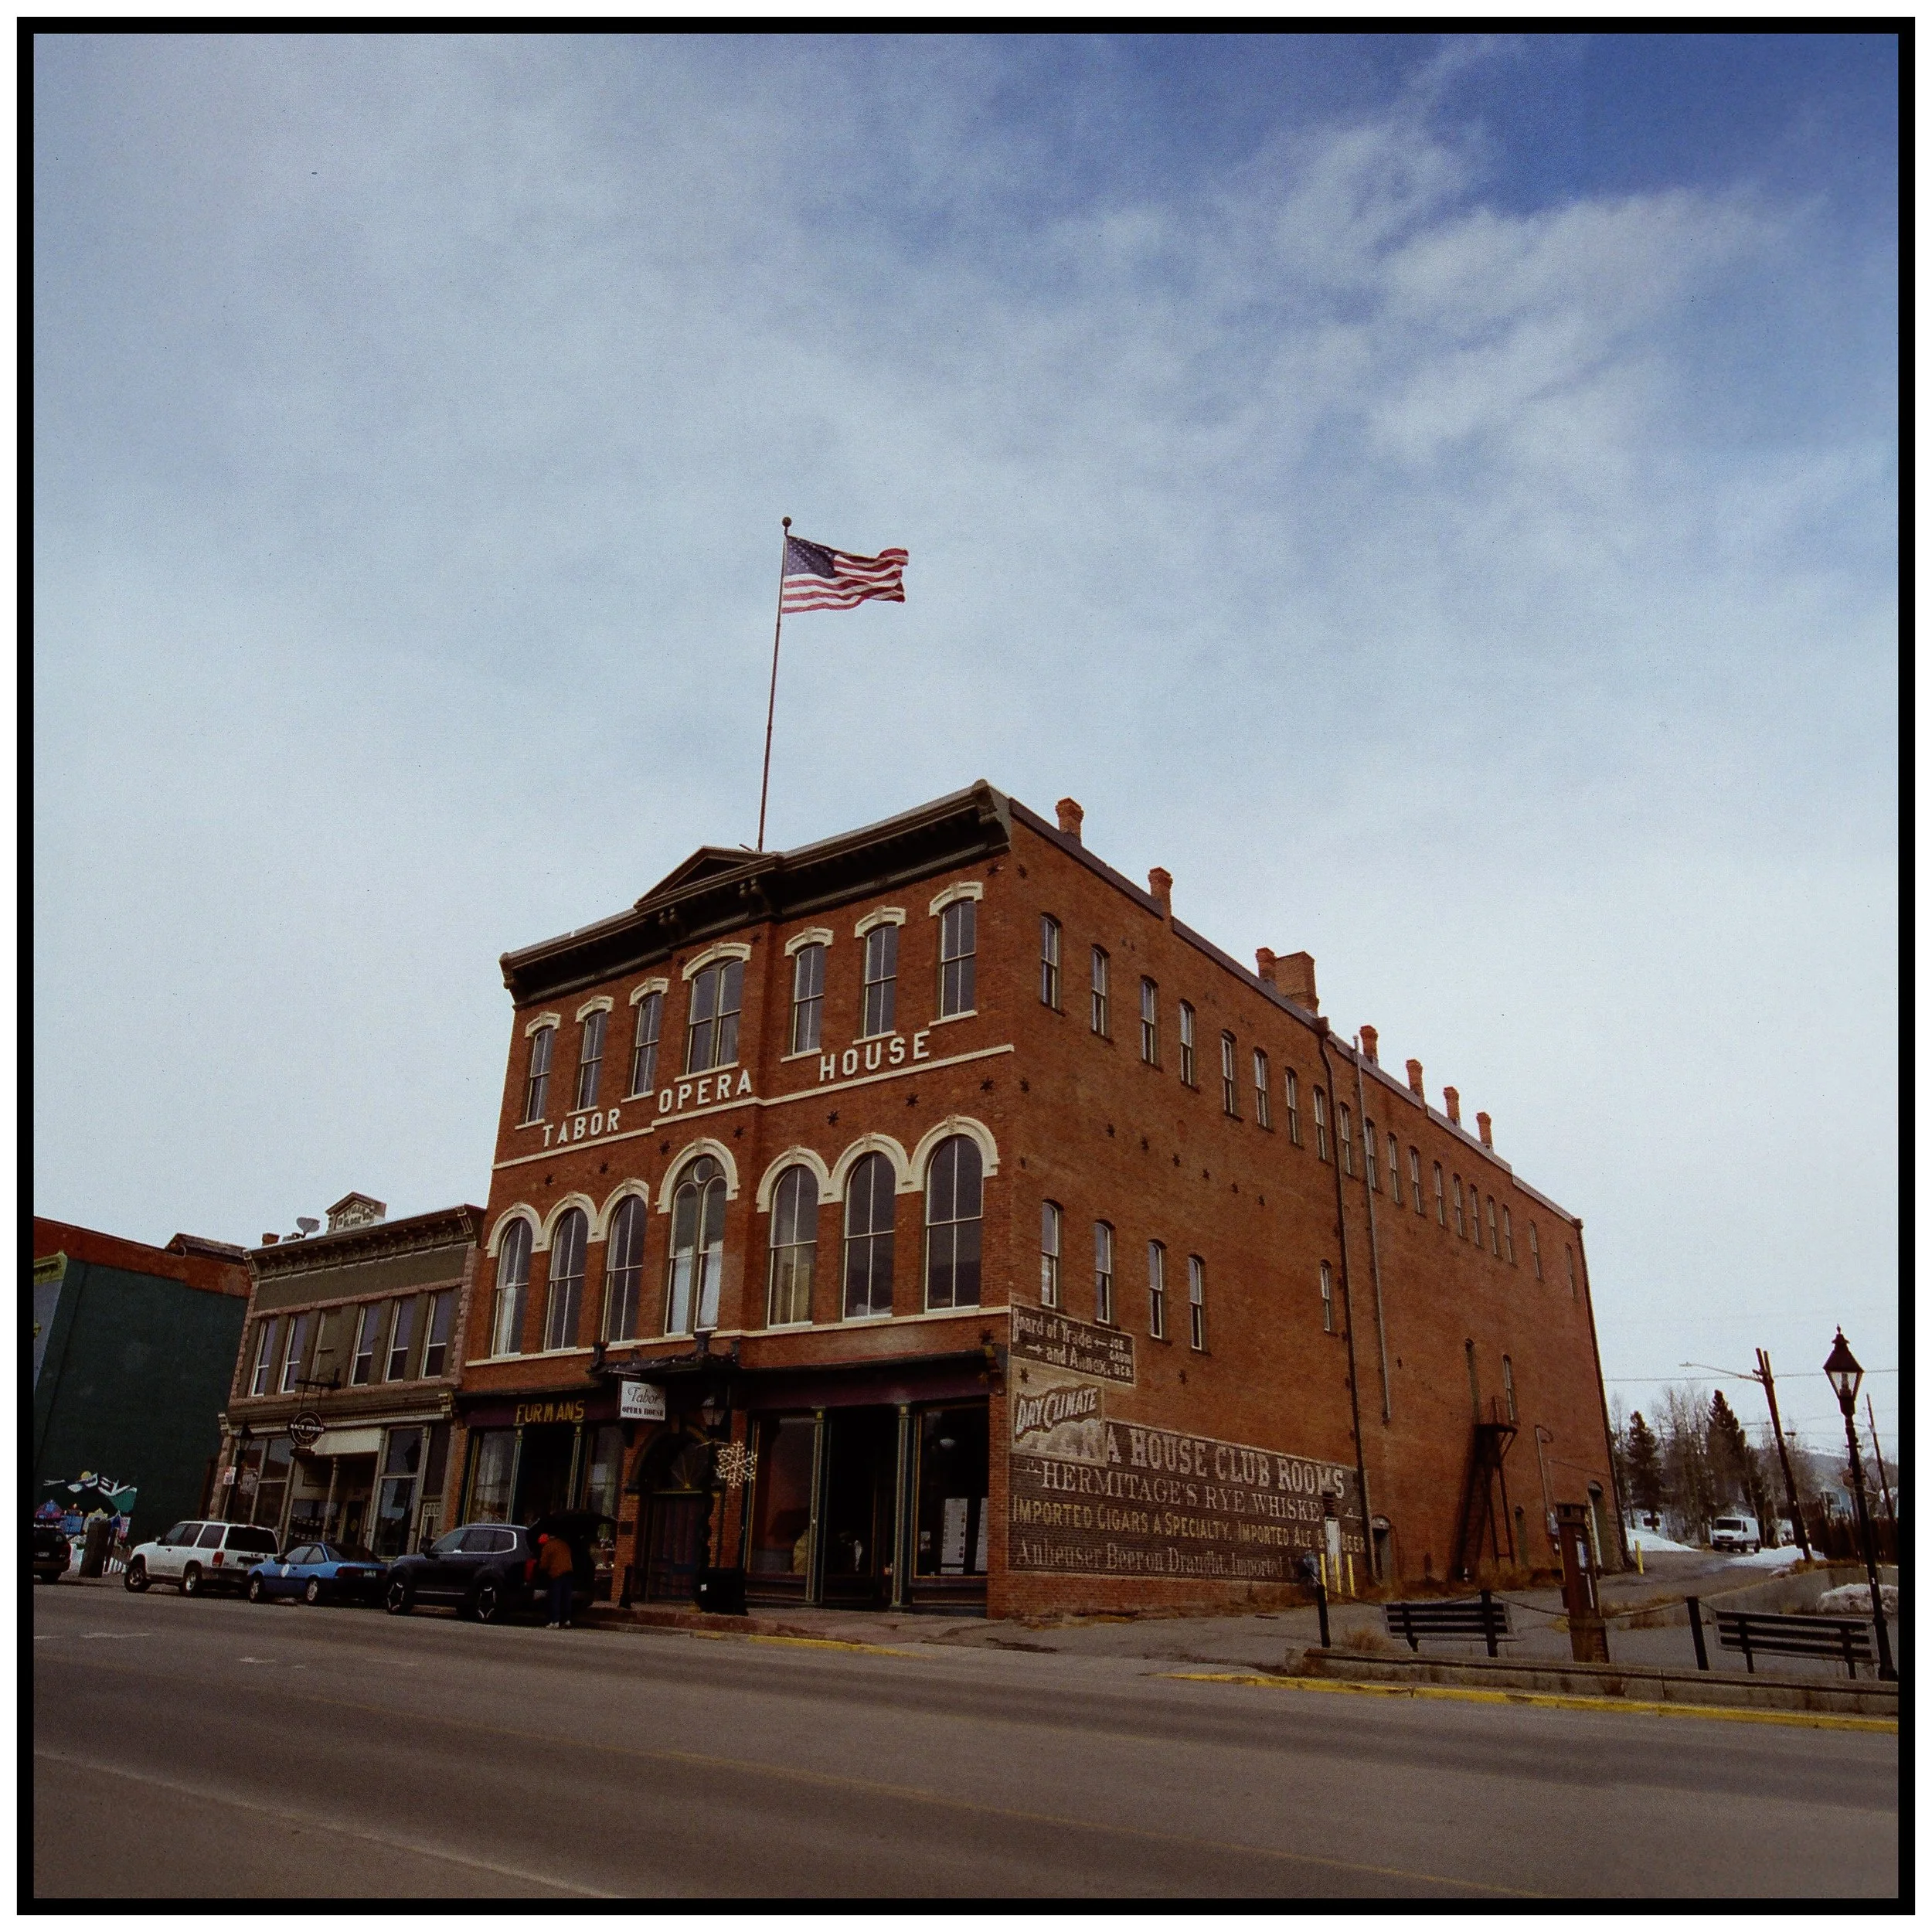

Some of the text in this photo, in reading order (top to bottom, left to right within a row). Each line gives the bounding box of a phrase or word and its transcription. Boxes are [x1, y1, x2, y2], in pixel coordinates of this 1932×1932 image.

[543, 1030, 930, 1147] TABOR OPERA HOUSE
[1012, 1308, 1093, 1349] Board of Trade
[1046, 1345, 1066, 1365] and
[515, 1399, 585, 1423] FURMANS
[627, 1386, 659, 1404] Tabor
[1044, 1387, 1098, 1428] CLIMATE
[1128, 1428, 1208, 1478] HOUSE
[1214, 1445, 1270, 1488] CLUB
[1277, 1458, 1345, 1499] ROOMS
[1041, 1461, 1198, 1507] HERMITAGE'S
[1204, 1485, 1246, 1512] RYE
[1251, 1492, 1324, 1522] WHISKE
[1012, 1495, 1093, 1529] IMPORTED
[1097, 1503, 1149, 1533] CIGARS
[1154, 1512, 1163, 1534] A
[1236, 1520, 1290, 1546] IMPORTED
[1294, 1526, 1312, 1548] ALE
[1015, 1537, 1104, 1569] Anheuser
[1107, 1543, 1142, 1571] Beer
